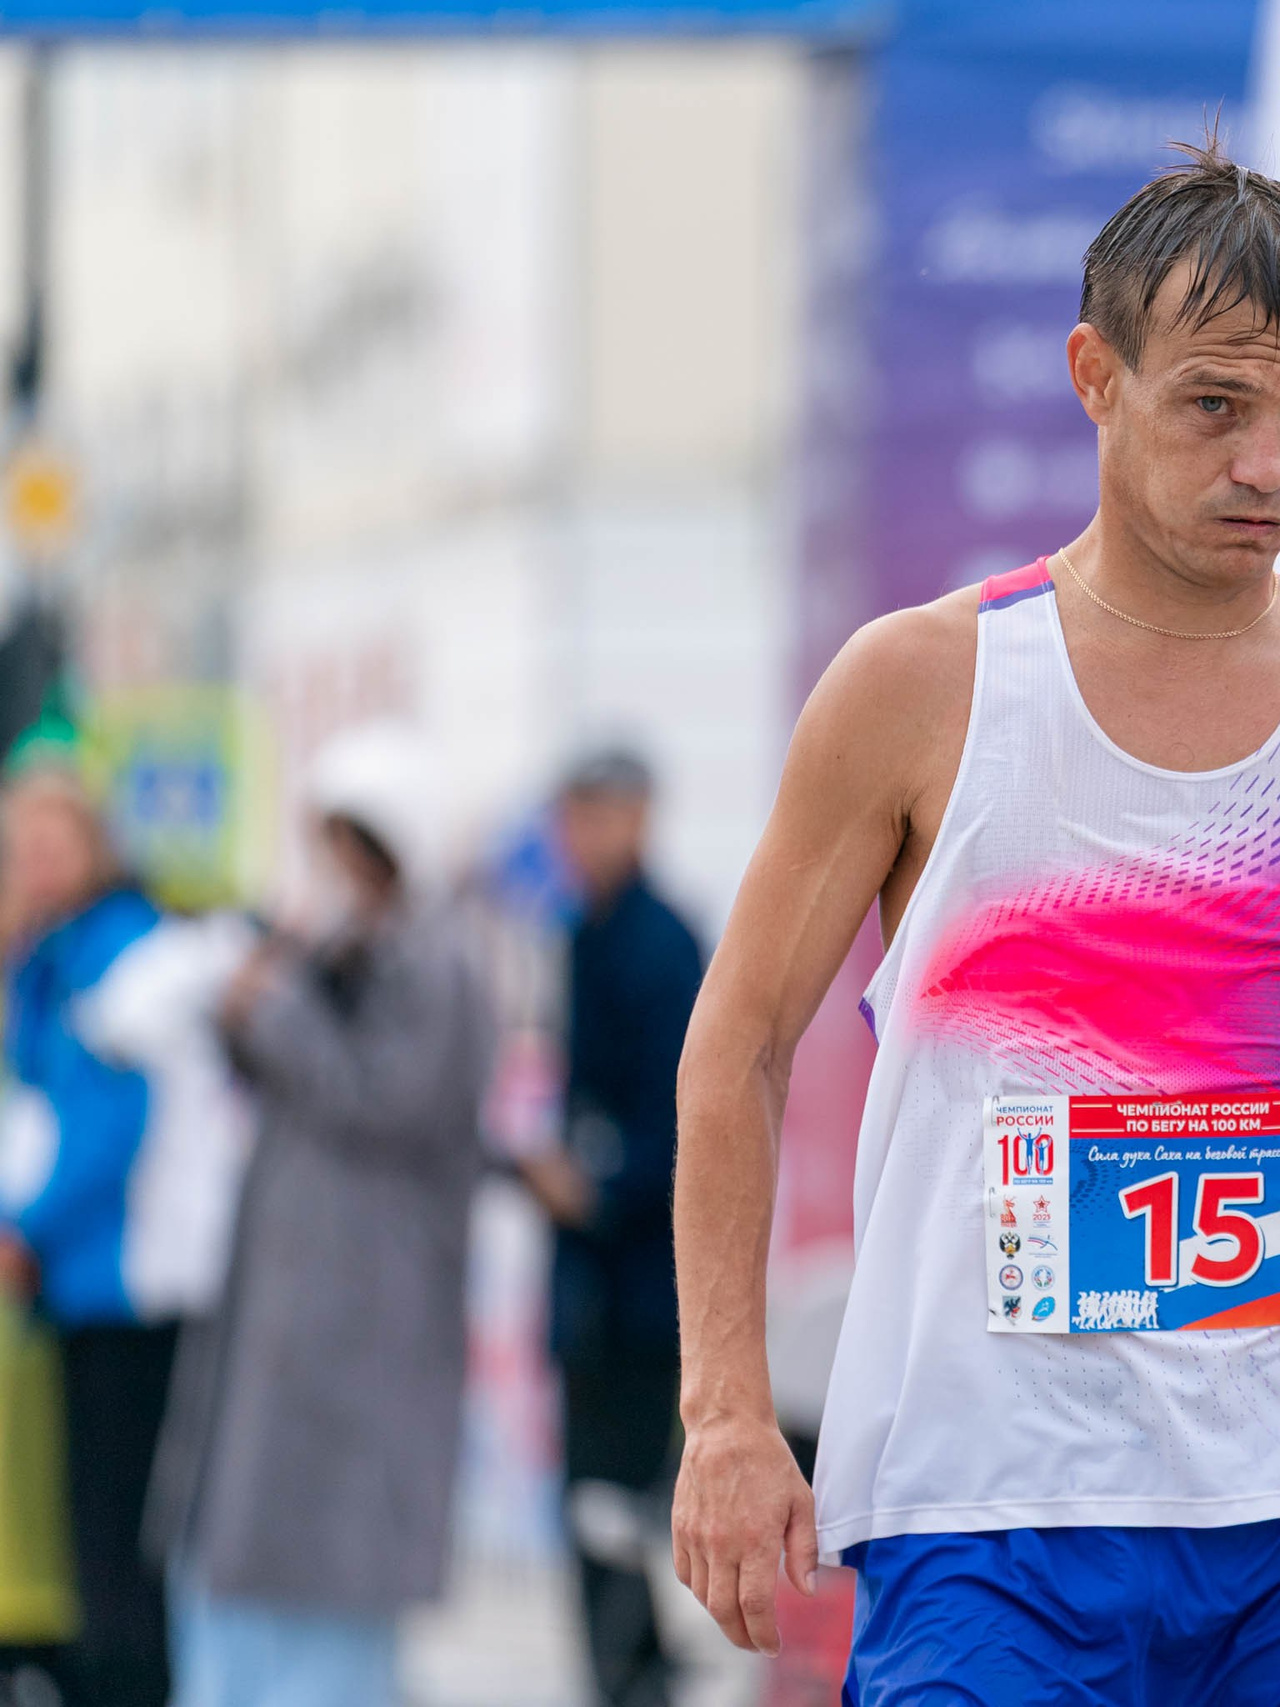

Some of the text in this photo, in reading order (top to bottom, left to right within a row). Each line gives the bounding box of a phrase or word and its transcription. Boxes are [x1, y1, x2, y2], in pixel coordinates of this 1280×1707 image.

[996, 1105, 1053, 1114] ЧЕМПИОНАТ
[1117, 1102, 1270, 1117] ЧЕМПИОНАТ РОССИИ
[996, 1115, 1054, 1127] РОССИИ
[1126, 1118, 1261, 1132] ПО БЕГУ НА 100 КМ
[997, 1133, 1054, 1186] 100
[1088, 1145, 1120, 1162] Сила
[1119, 1151, 1152, 1168] духа
[1154, 1145, 1183, 1161] Саха
[1185, 1151, 1203, 1161] на
[1204, 1144, 1248, 1161] беговой
[1118, 1171, 1265, 1288] 15
